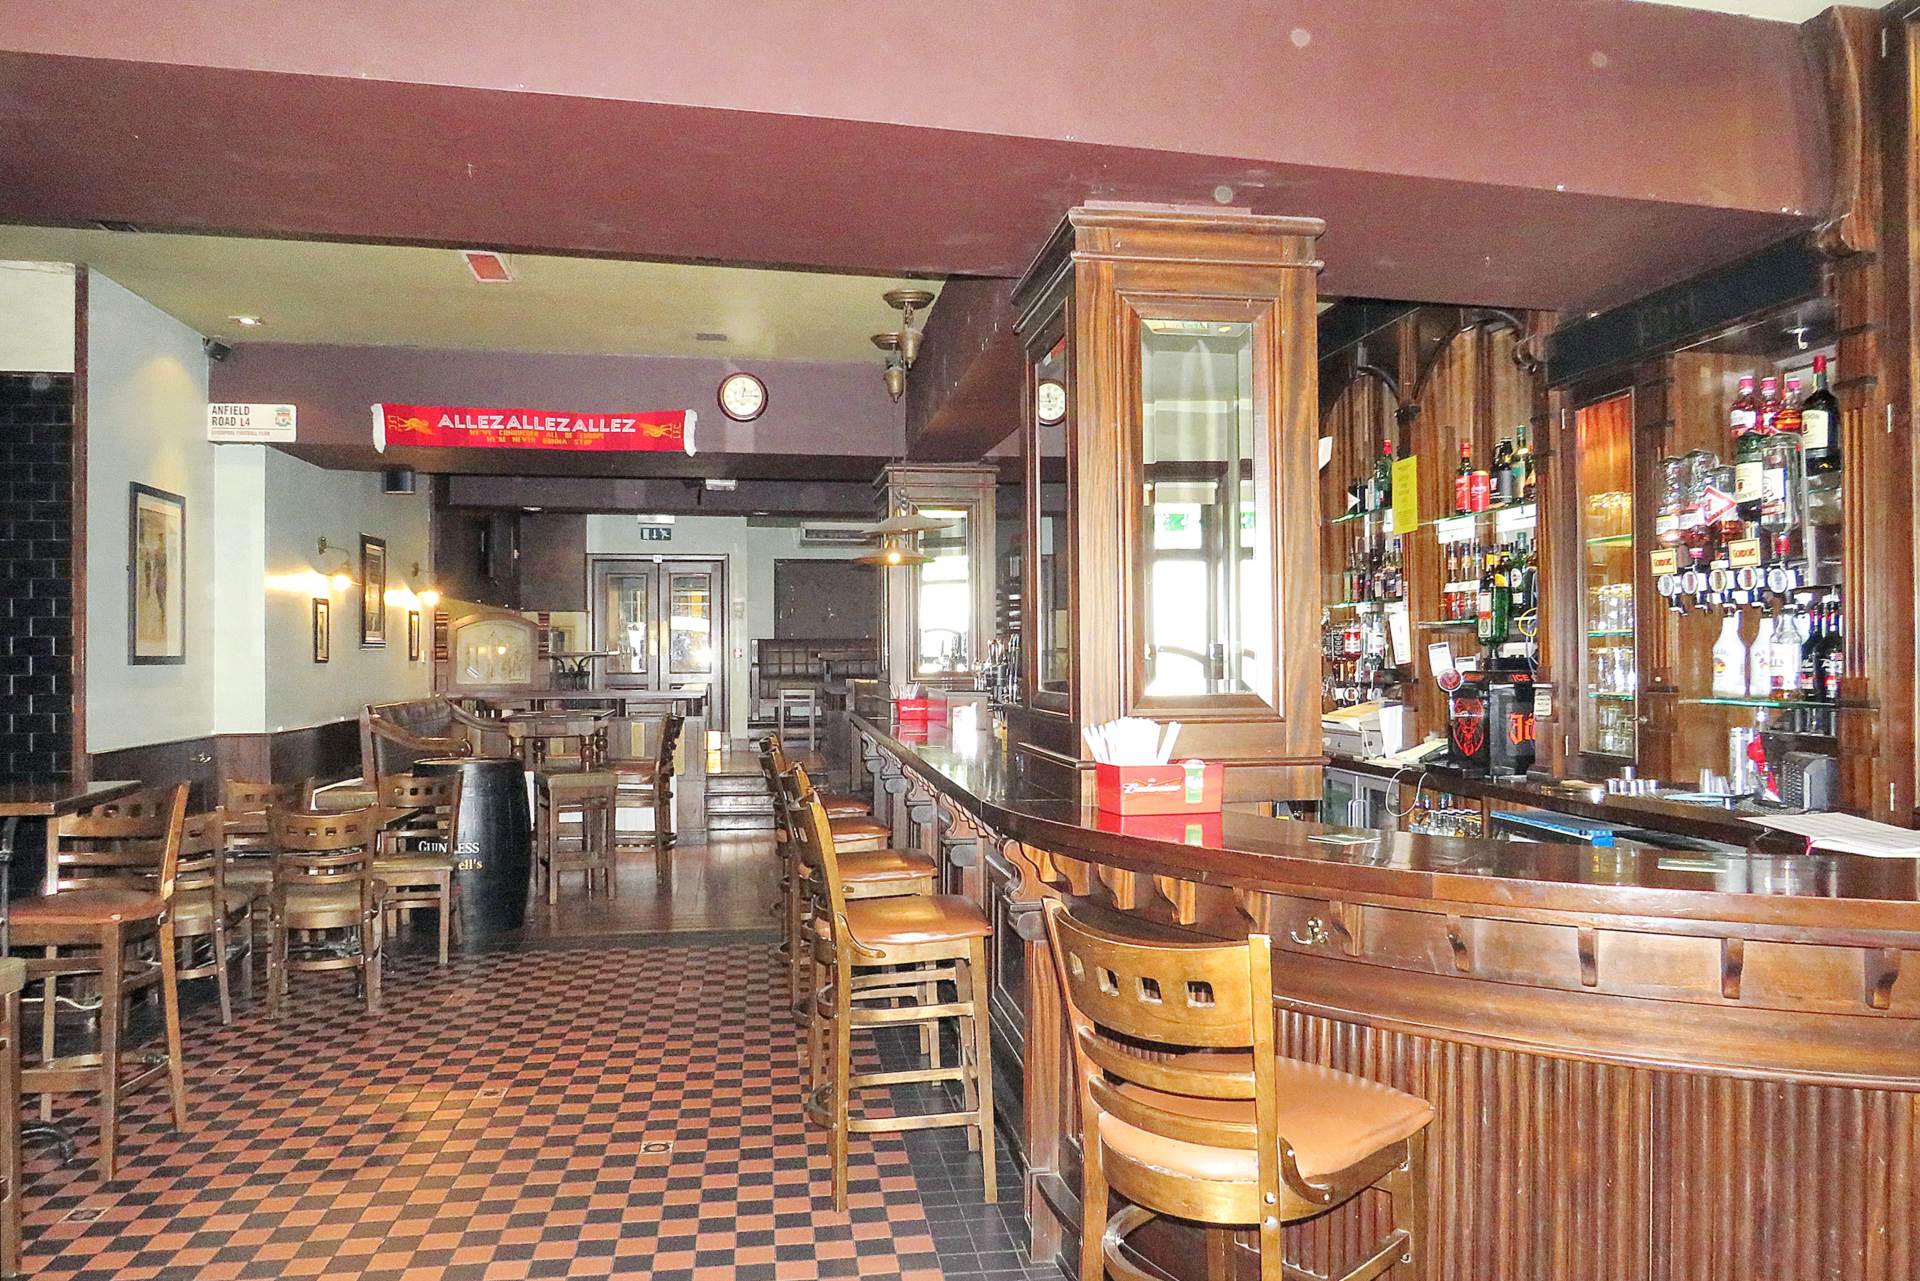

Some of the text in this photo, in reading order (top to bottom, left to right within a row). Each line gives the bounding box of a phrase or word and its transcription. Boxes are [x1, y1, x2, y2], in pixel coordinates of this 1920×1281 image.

[212, 406, 250, 416] ANFIELD
[212, 417, 250, 427] ROAD L4
[418, 840, 480, 854] GUINESS
[458, 858, 483, 871] ell's
